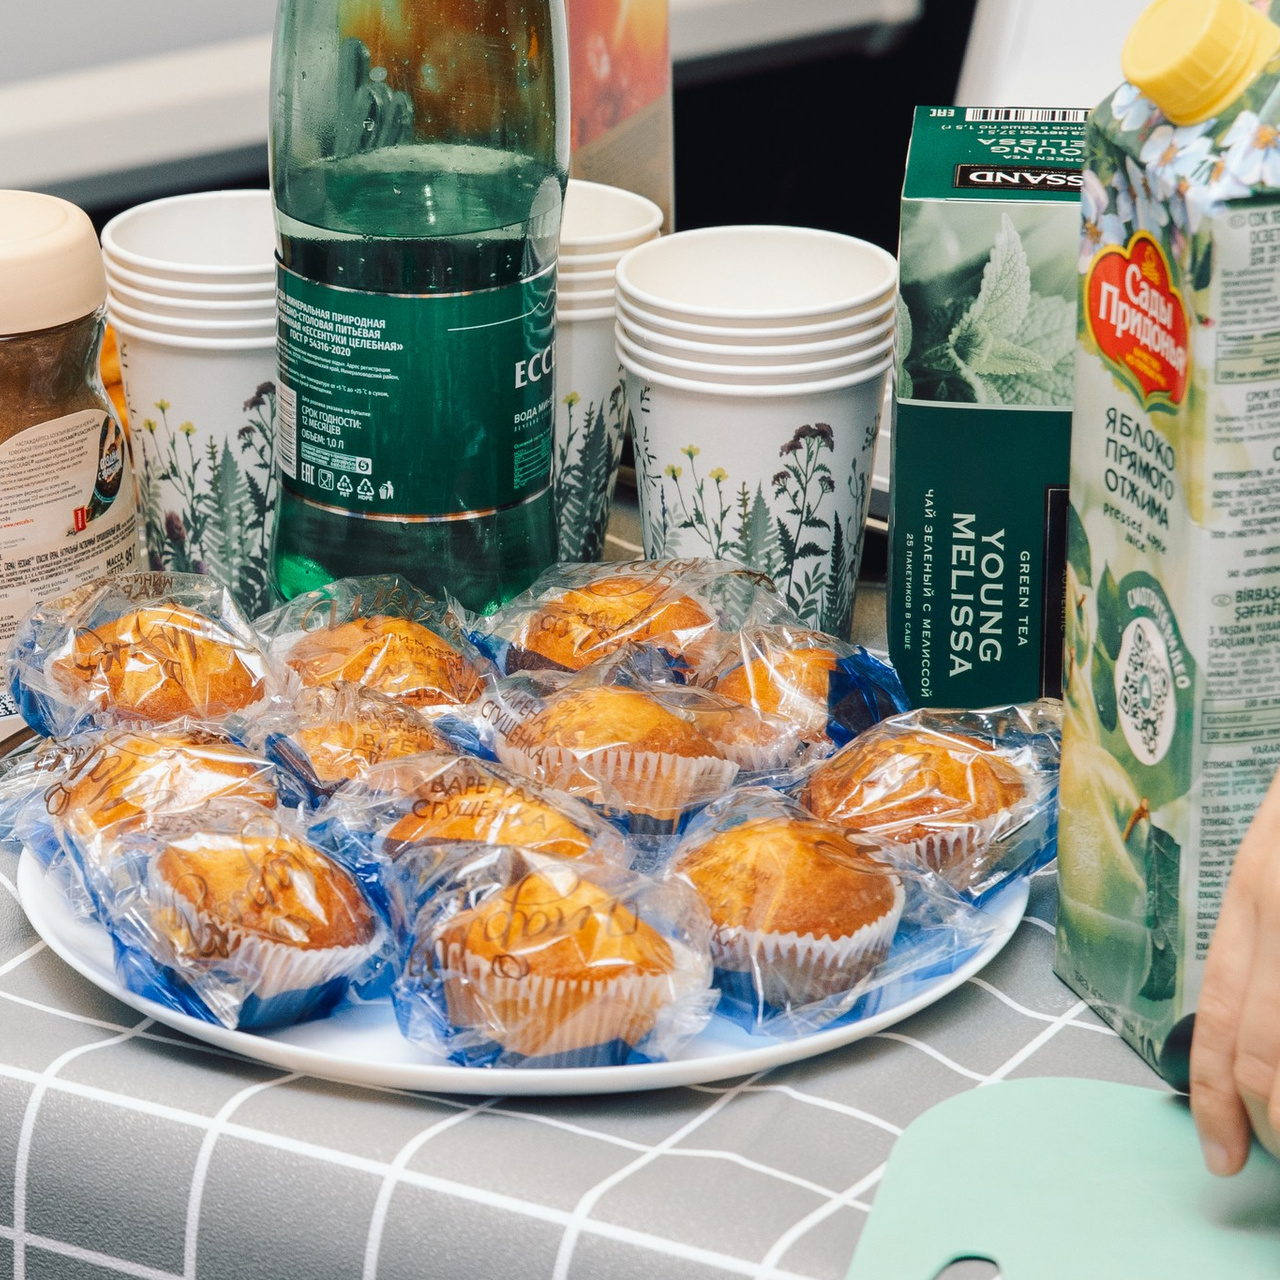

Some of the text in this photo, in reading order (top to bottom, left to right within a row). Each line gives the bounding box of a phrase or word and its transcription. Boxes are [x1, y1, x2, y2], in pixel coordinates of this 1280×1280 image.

[977, 138, 1085, 148] ELISSA
[990, 146, 1083, 156] OUNG
[969, 171, 1084, 187] SSAND
[286, 294, 387, 329] МИНЕРАЛЬНАЯ ПРИРОДНАЯ
[1125, 263, 1174, 331] Сады
[289, 328, 304, 342] ГОСТ
[309, 338, 352, 357] 54316-2020
[301, 325, 404, 352] «ЕССЕНТУКИ ЦЕЛЕБНАЯ»
[335, 323, 381, 340] ПИТЬЕВАЯ
[301, 404, 362, 430] СРОК ГОДНОСТИ:
[301, 415, 341, 436] 12 МЕСЯЦЕВ
[513, 406, 538, 424] ВОДА
[326, 436, 337, 448] 1,0
[337, 439, 345, 449] Л
[1106, 407, 1176, 471] ЯБЛОКО
[1106, 436, 1174, 501] ПРЯМОГО
[1105, 468, 1169, 530] ОТЖИМА
[1103, 502, 1143, 534] pressed
[904, 532, 914, 651] 25 ПАКЕТИКОВ В САШЕ
[920, 489, 937, 698] ЧАЙ ЗЕЛЕНЫЙ С МЕЛИССОЙ
[949, 512, 976, 678] MELISSA
[978, 528, 1006, 663] YOUNG
[1017, 550, 1031, 647] GREEN TEA
[481, 700, 548, 766] СГУЩЕНКА
